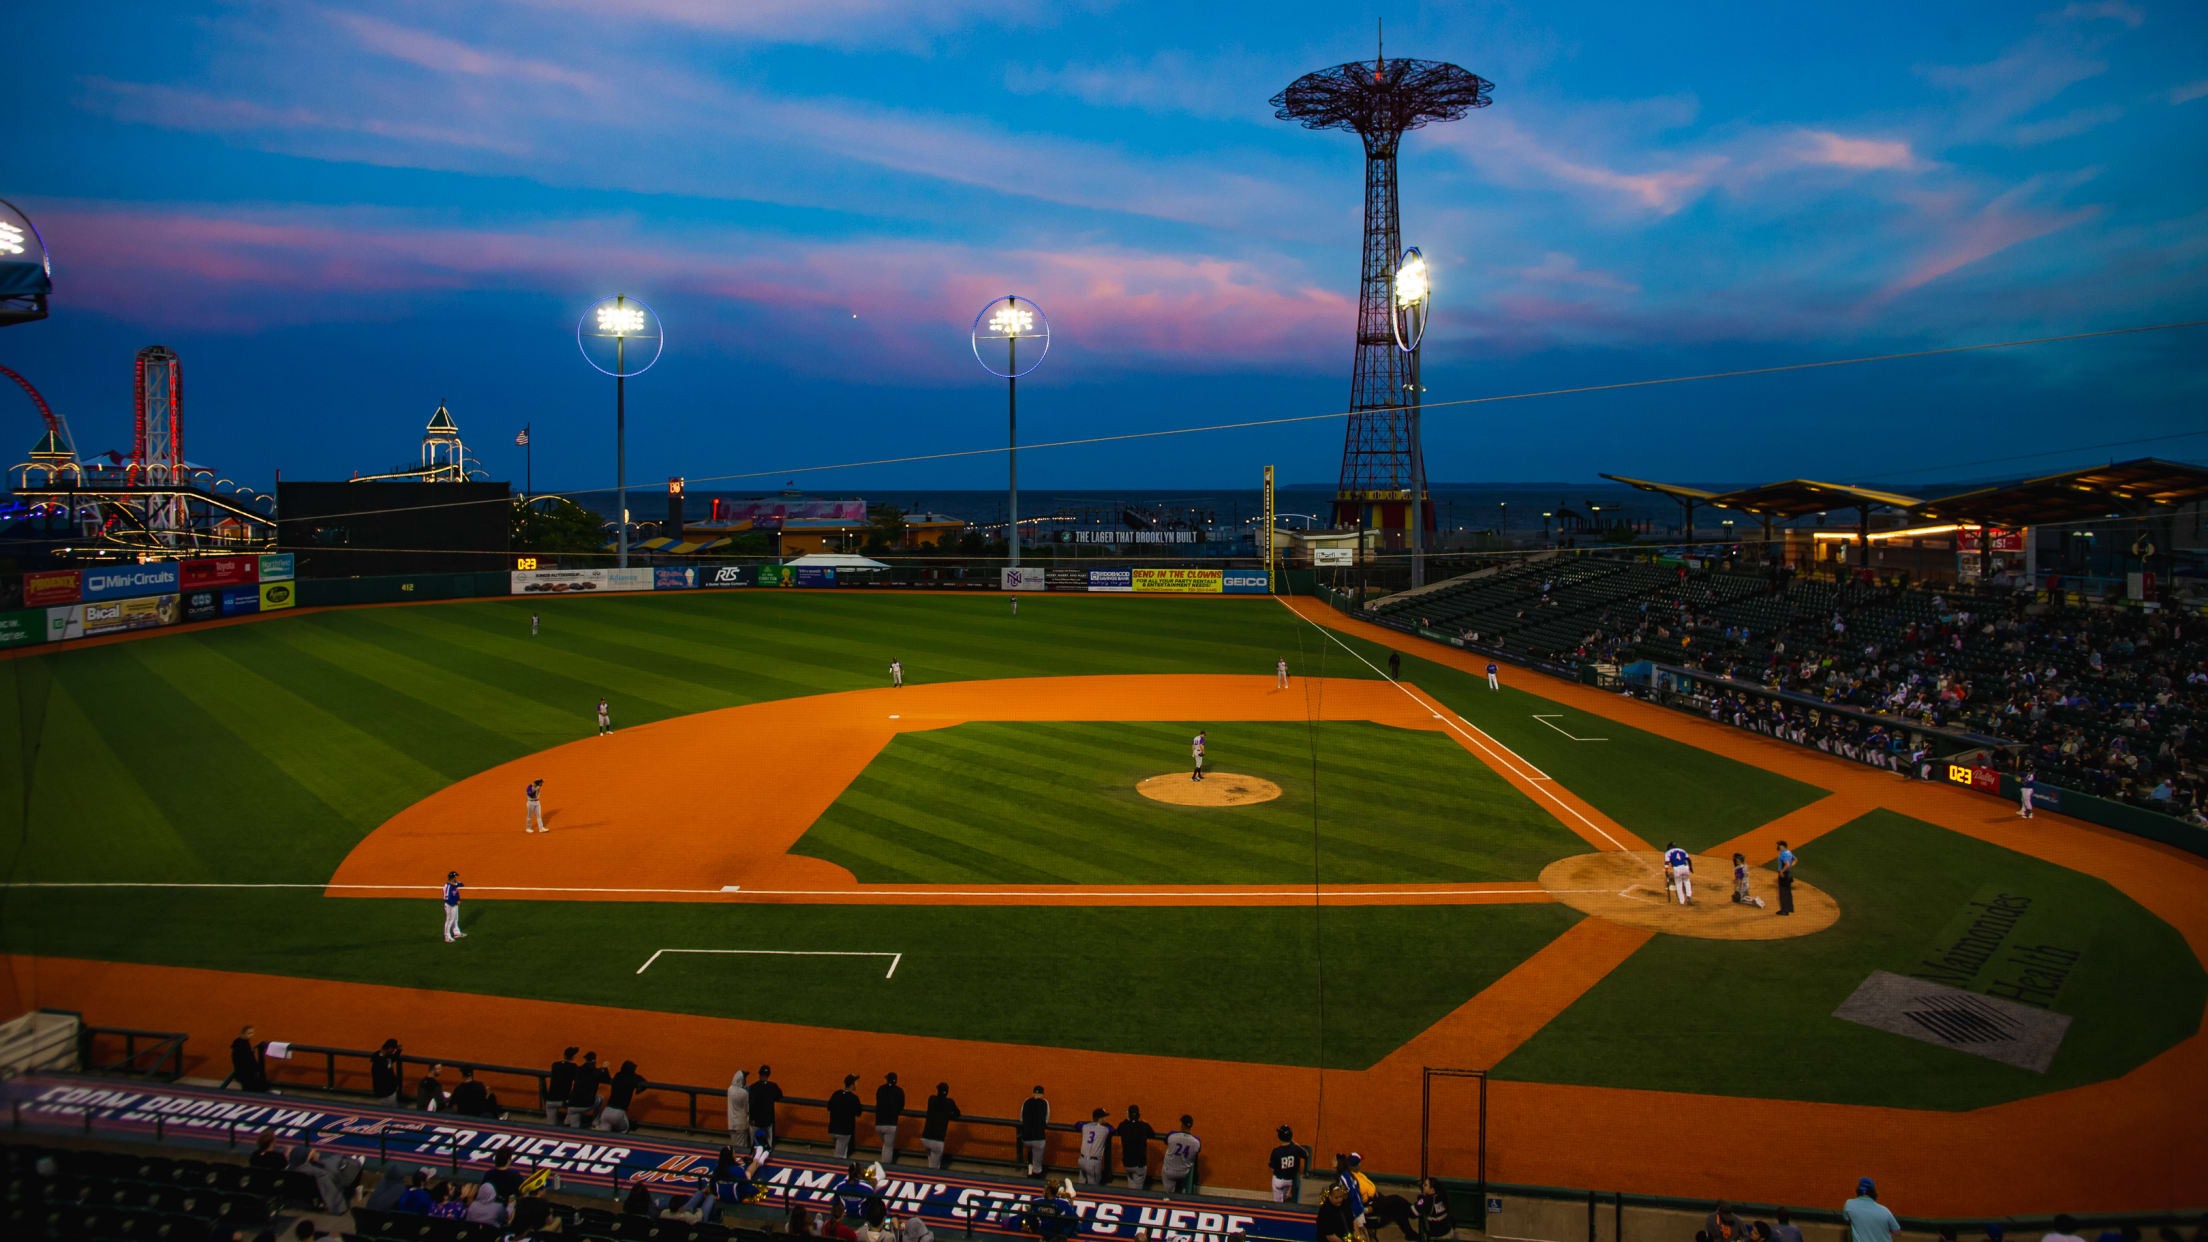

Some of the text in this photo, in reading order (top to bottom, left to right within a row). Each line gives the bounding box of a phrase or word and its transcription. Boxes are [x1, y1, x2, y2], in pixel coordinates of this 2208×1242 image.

[1076, 531, 1197, 543] THE LAGER THAT BROOKLYN BUILT
[106, 571, 174, 588] Mini-Circuits
[714, 567, 740, 582] RTS
[1133, 570, 1222, 578] SEND IN THE CLOWNS
[1223, 577, 1267, 586] GEICO
[87, 604, 120, 621] Bical
[1908, 893, 2032, 989] Maimonides
[1985, 945, 2081, 1009] Health
[1087, 1131, 1095, 1144] 3
[1174, 1143, 1191, 1158] 24
[119, 1095, 326, 1138] BROOKLYN
[414, 1126, 478, 1155] TO
[468, 1132, 631, 1175] QUEENS
[1134, 1206, 1255, 1242] HERE
